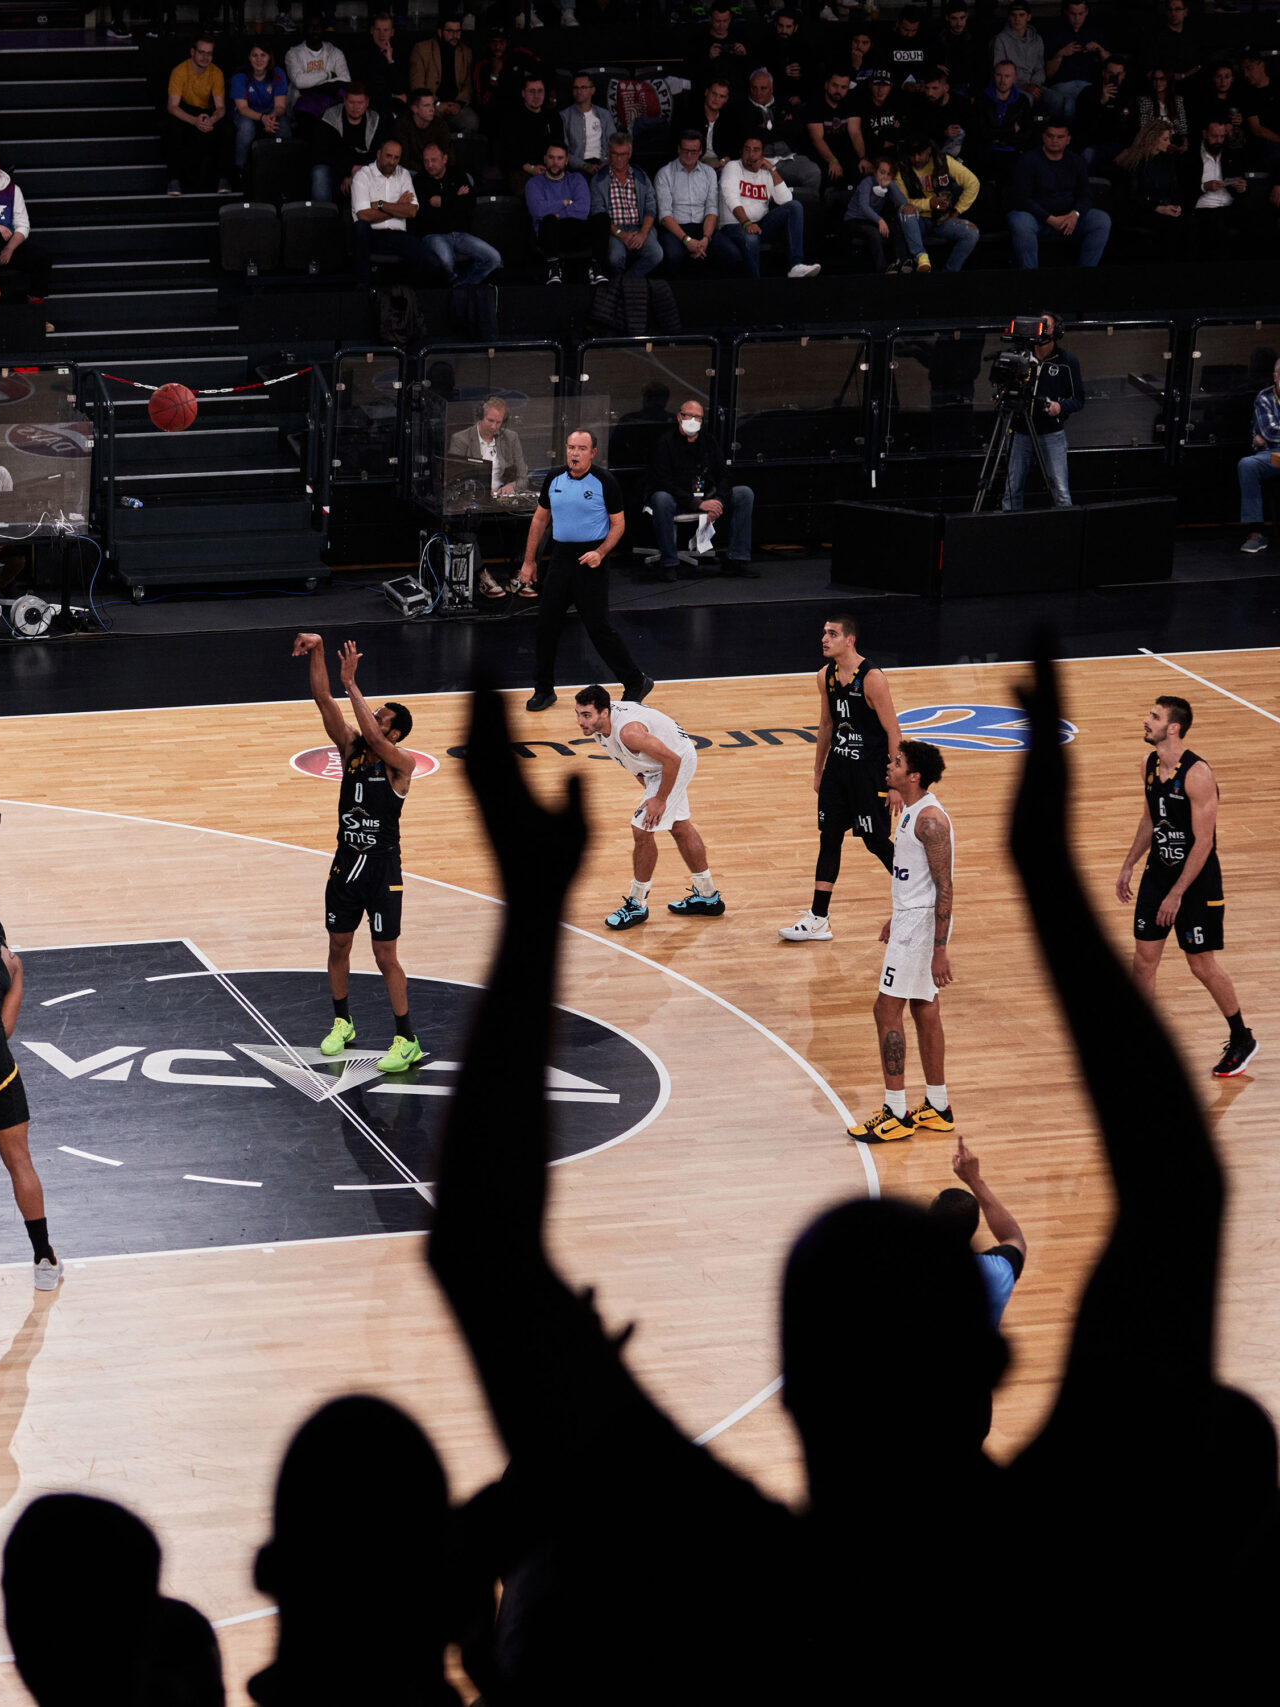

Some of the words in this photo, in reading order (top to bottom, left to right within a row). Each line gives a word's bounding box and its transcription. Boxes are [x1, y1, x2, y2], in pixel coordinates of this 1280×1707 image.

[740, 182, 770, 198] ICON
[837, 698, 851, 718] 41
[848, 732, 863, 742] NIS
[833, 745, 860, 760] mts
[354, 782, 363, 803] 0
[362, 818, 380, 828] NIS
[858, 815, 873, 833] 41
[344, 830, 377, 845] mts
[1168, 831, 1186, 840] NIS
[374, 911, 383, 932] 0
[883, 966, 896, 988] 5
